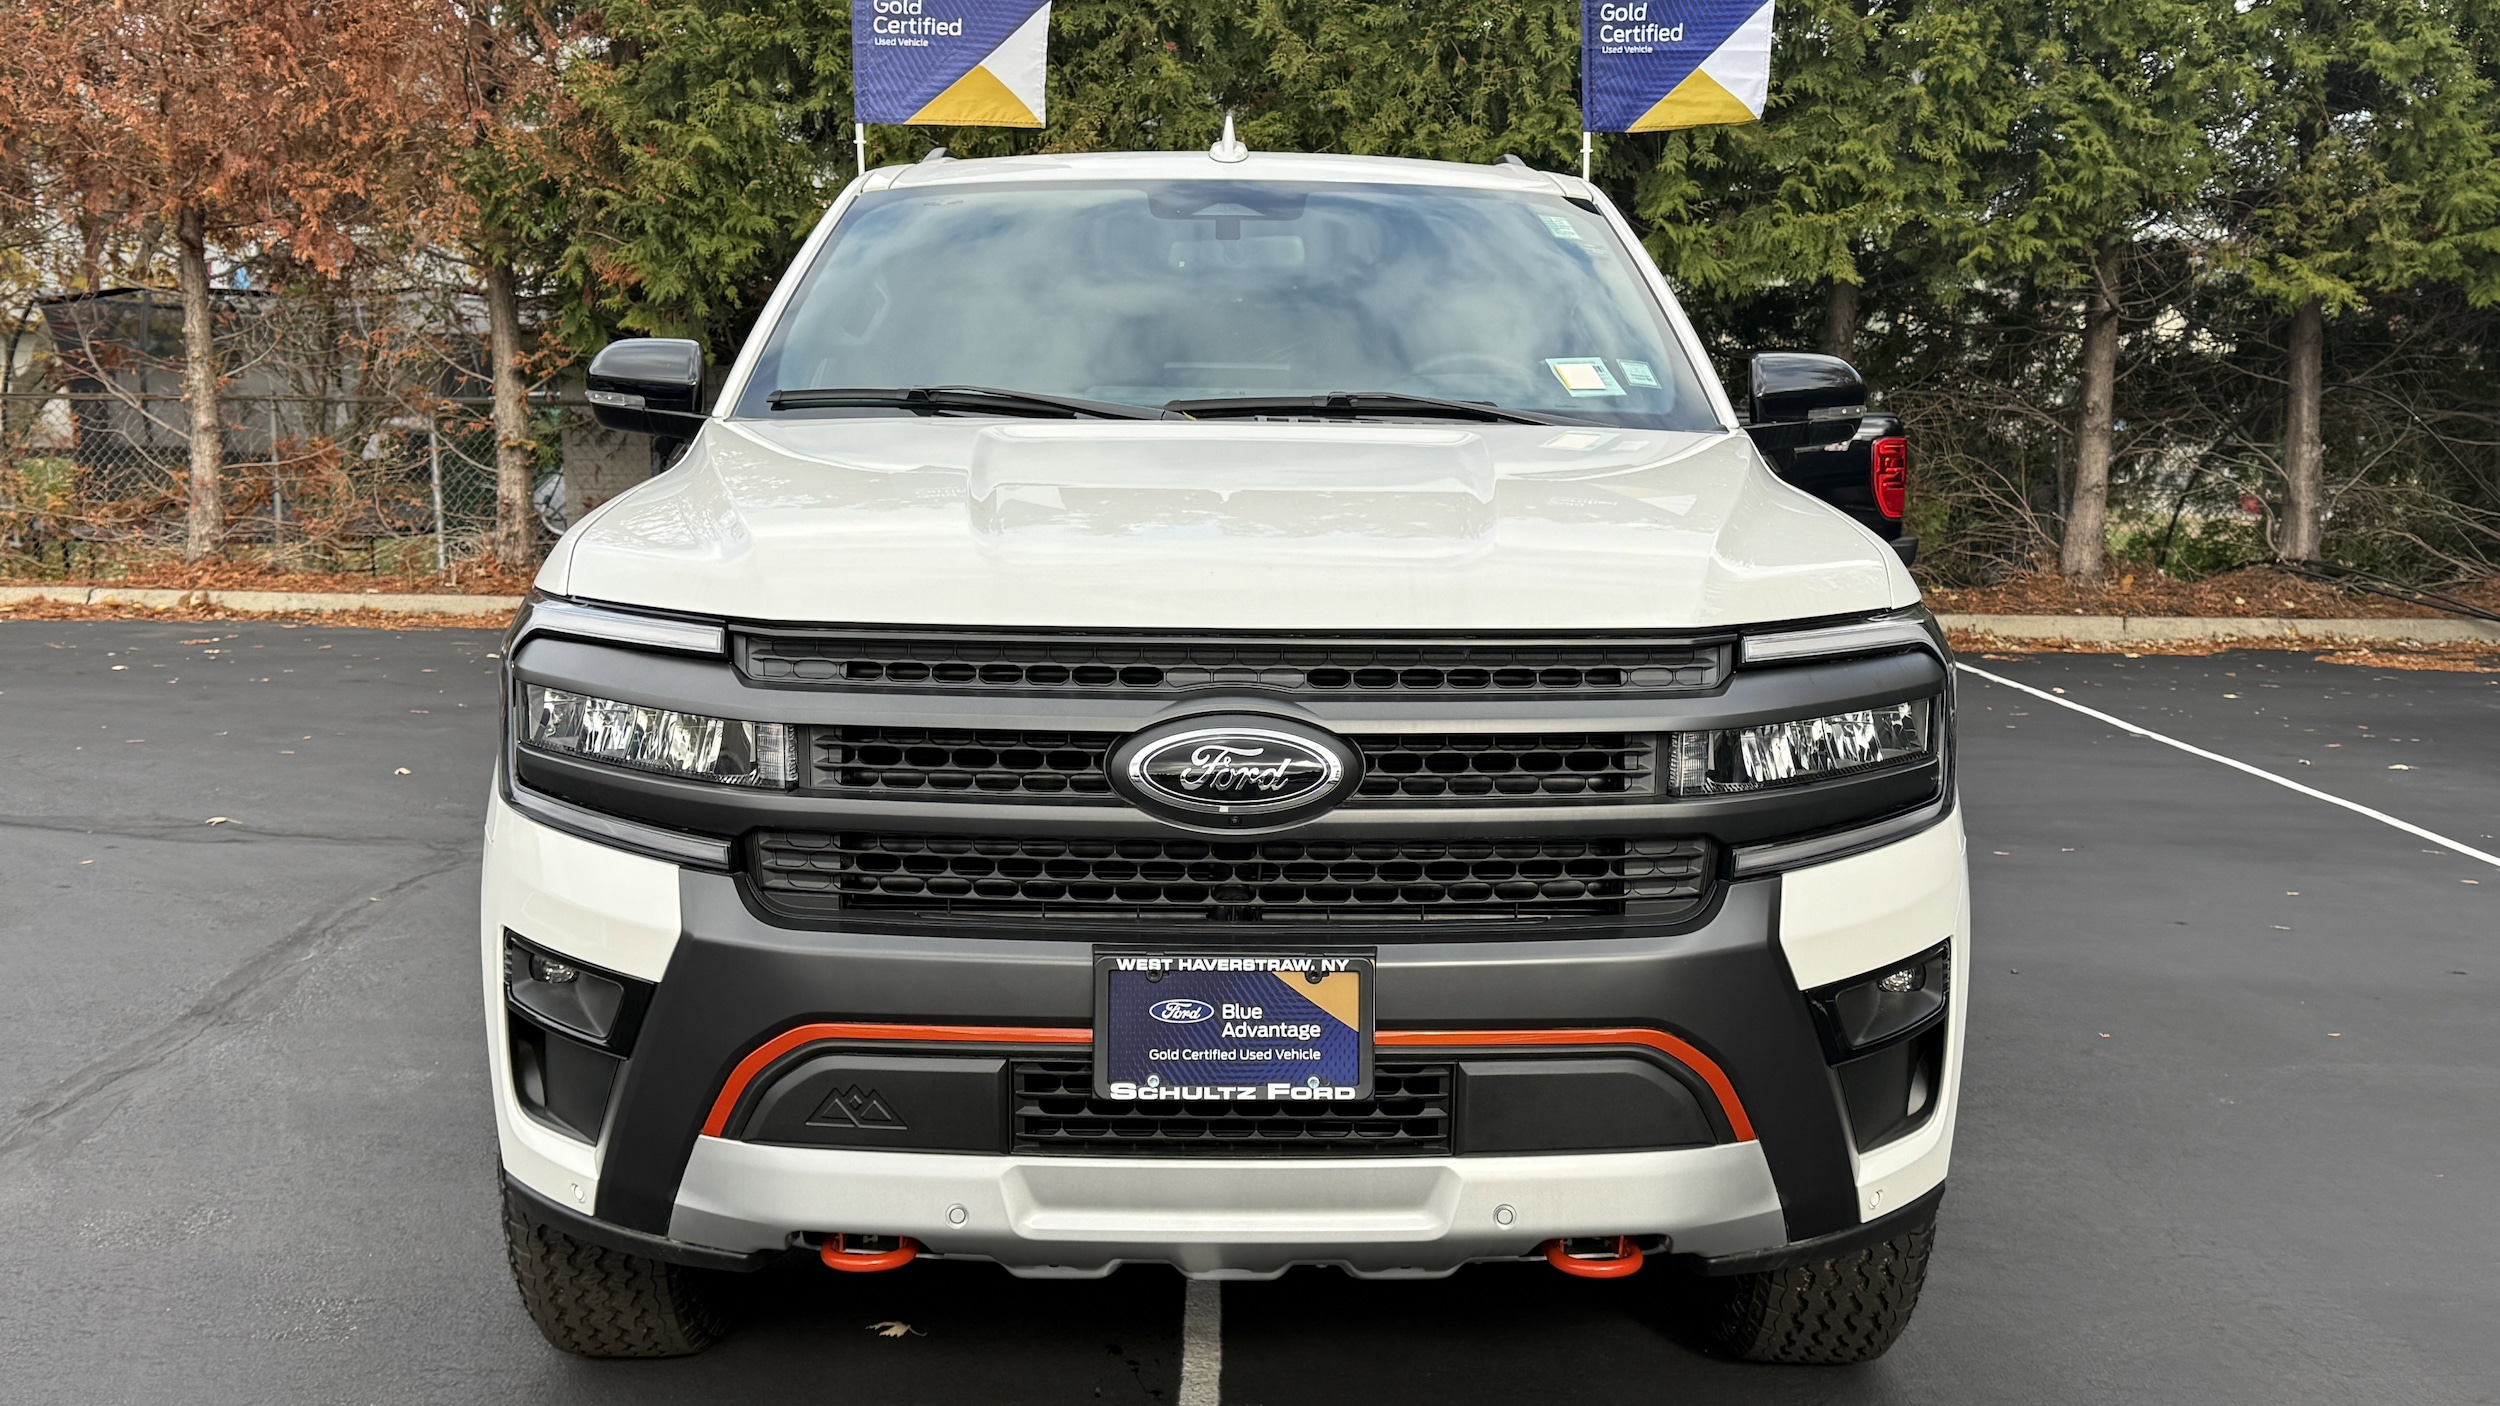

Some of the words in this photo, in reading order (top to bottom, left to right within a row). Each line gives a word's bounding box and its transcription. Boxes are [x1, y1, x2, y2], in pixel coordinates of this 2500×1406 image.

[873, 0, 922, 15] Gold
[1600, 2, 1648, 22] Gold
[873, 16, 963, 36] Certified
[1600, 22, 1684, 43] Certified
[874, 37, 897, 46] Used
[897, 38, 929, 47] Vehicle
[1601, 45, 1623, 54] Used
[1624, 45, 1653, 54] Vehicle
[1179, 744, 1292, 791] Ford
[1116, 958, 1173, 971] WEST
[1321, 959, 1350, 972] NY
[1161, 1003, 1202, 1020] Ford
[1221, 1004, 1263, 1020] Blue
[1221, 1022, 1321, 1041] Advantage
[1149, 1049, 1180, 1061] Gold
[1182, 1049, 1237, 1061] Certified
[1239, 1049, 1272, 1061] Used
[1274, 1049, 1321, 1061] Vehicle
[1110, 1082, 1257, 1101] SCHULTZ
[1267, 1083, 1356, 1101] FORD
